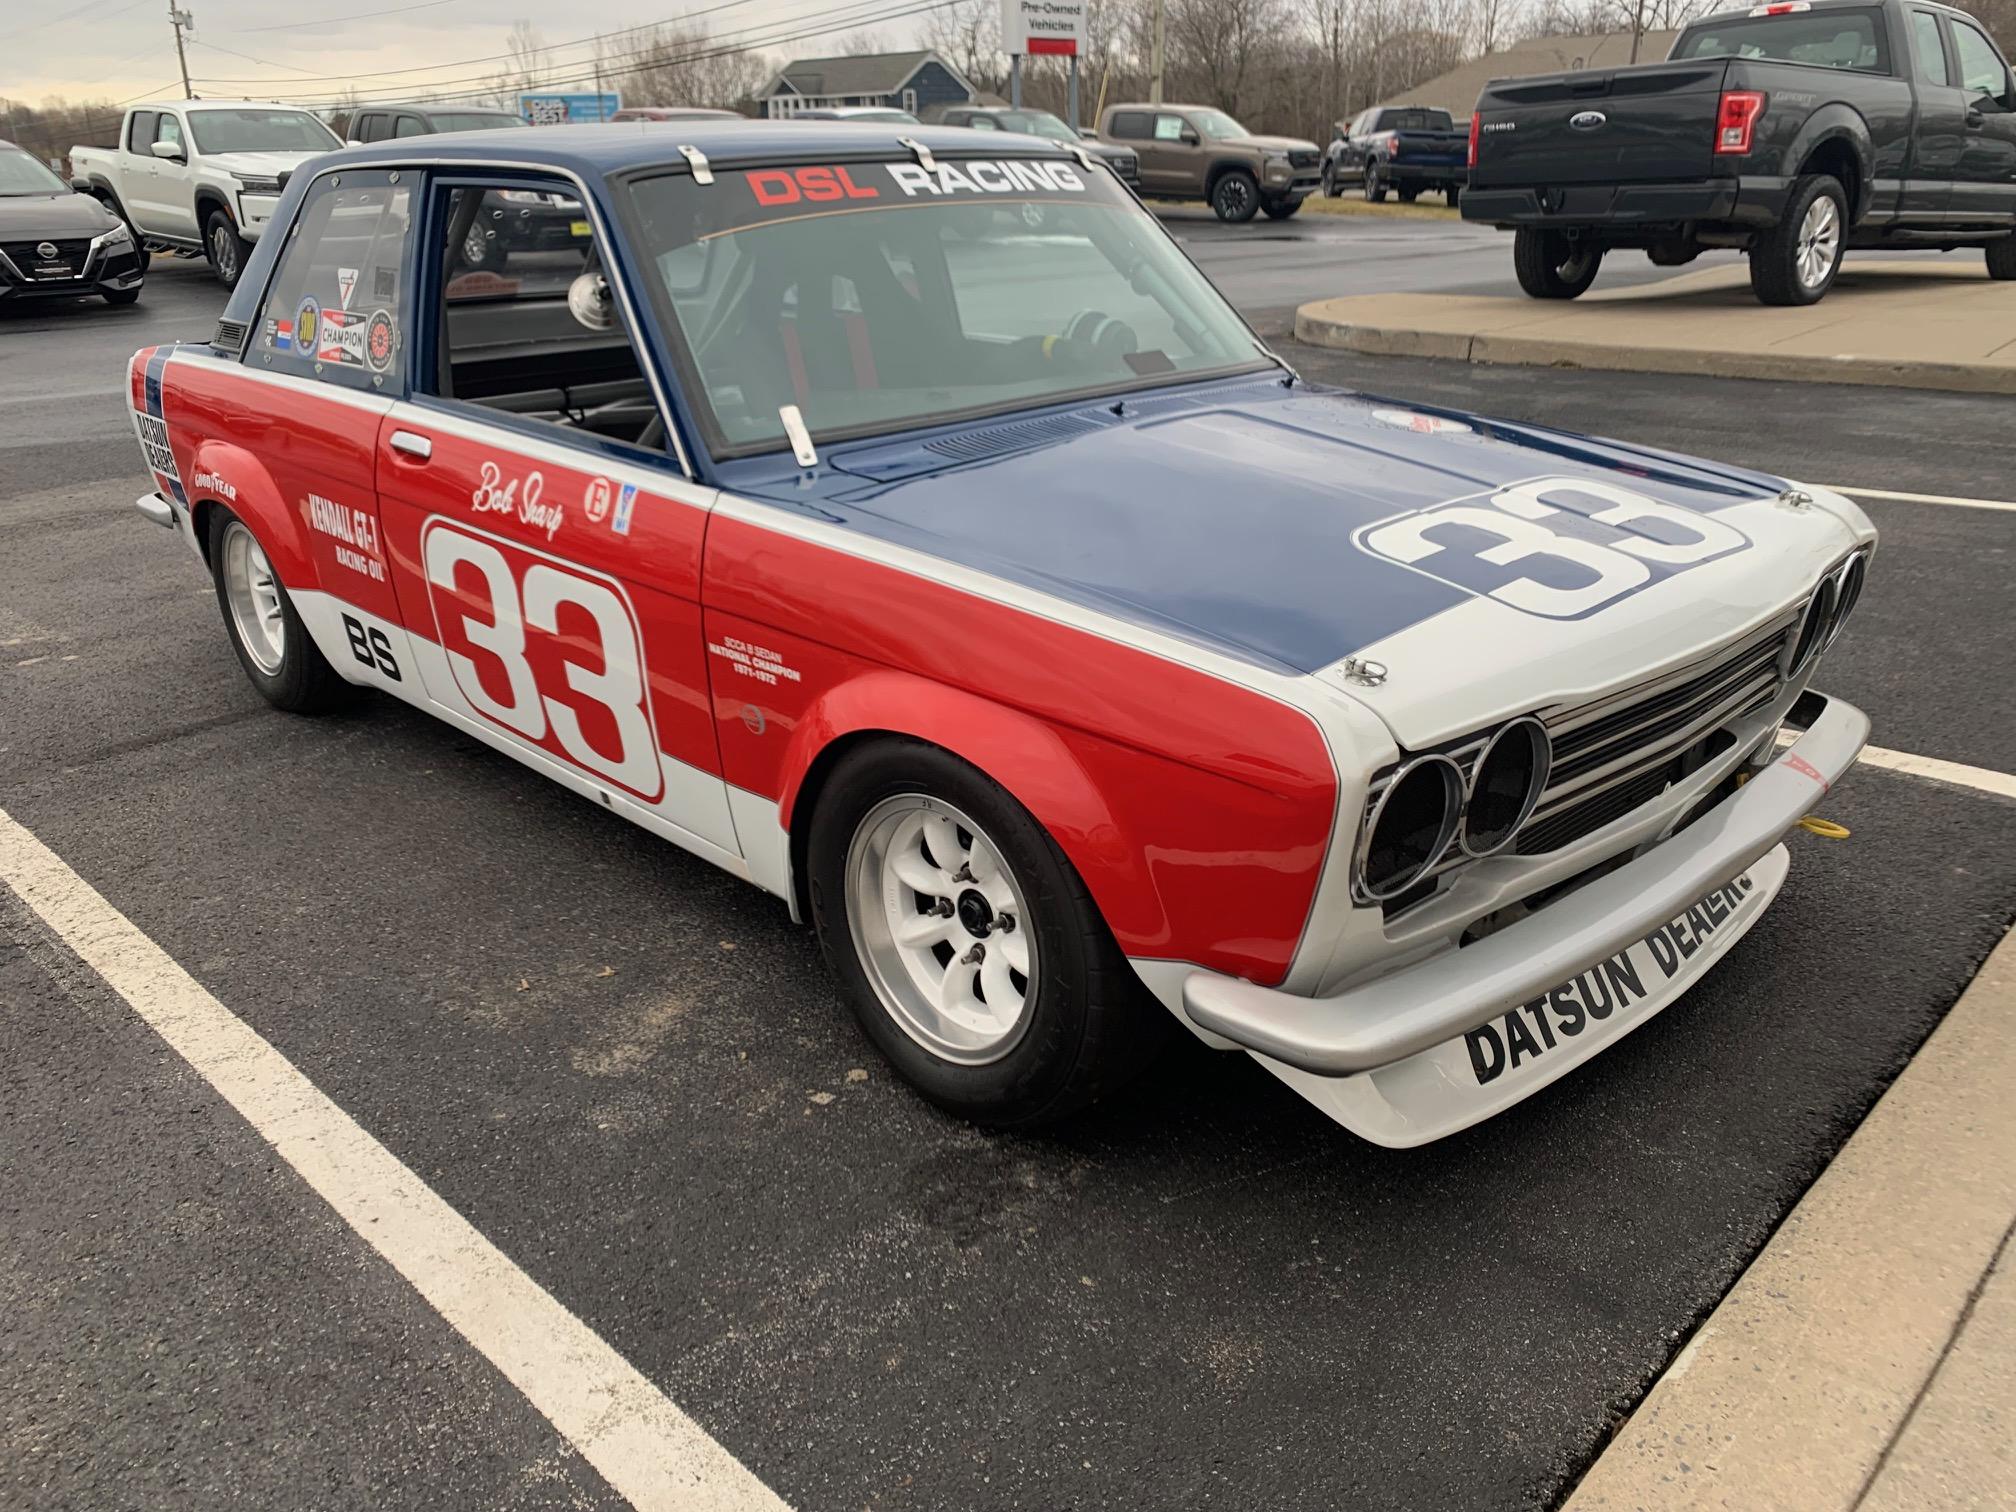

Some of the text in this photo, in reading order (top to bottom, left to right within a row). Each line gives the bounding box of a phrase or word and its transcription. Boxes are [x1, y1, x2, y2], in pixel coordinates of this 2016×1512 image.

[1021, 2, 1081, 15] Pre-Owned
[1028, 18, 1074, 31] Vehicles
[533, 109, 565, 122] BEST
[744, 160, 1086, 206] DSL RACING
[322, 328, 363, 347] CHAMPION
[136, 413, 170, 449] DATSUN
[472, 461, 563, 542] Bob Sharp
[308, 493, 379, 554] KENDALL GT-1
[335, 545, 385, 582] RACING OIL
[1368, 479, 1746, 616] 33
[341, 612, 402, 682] BS
[425, 526, 662, 798] 33
[708, 642, 801, 682] NATIONAL CHAMPION
[723, 636, 747, 652] SCCA
[753, 645, 782, 664] SEDAN
[733, 662, 778, 685] 1971-1972
[1464, 950, 1647, 1086] DATSUN
